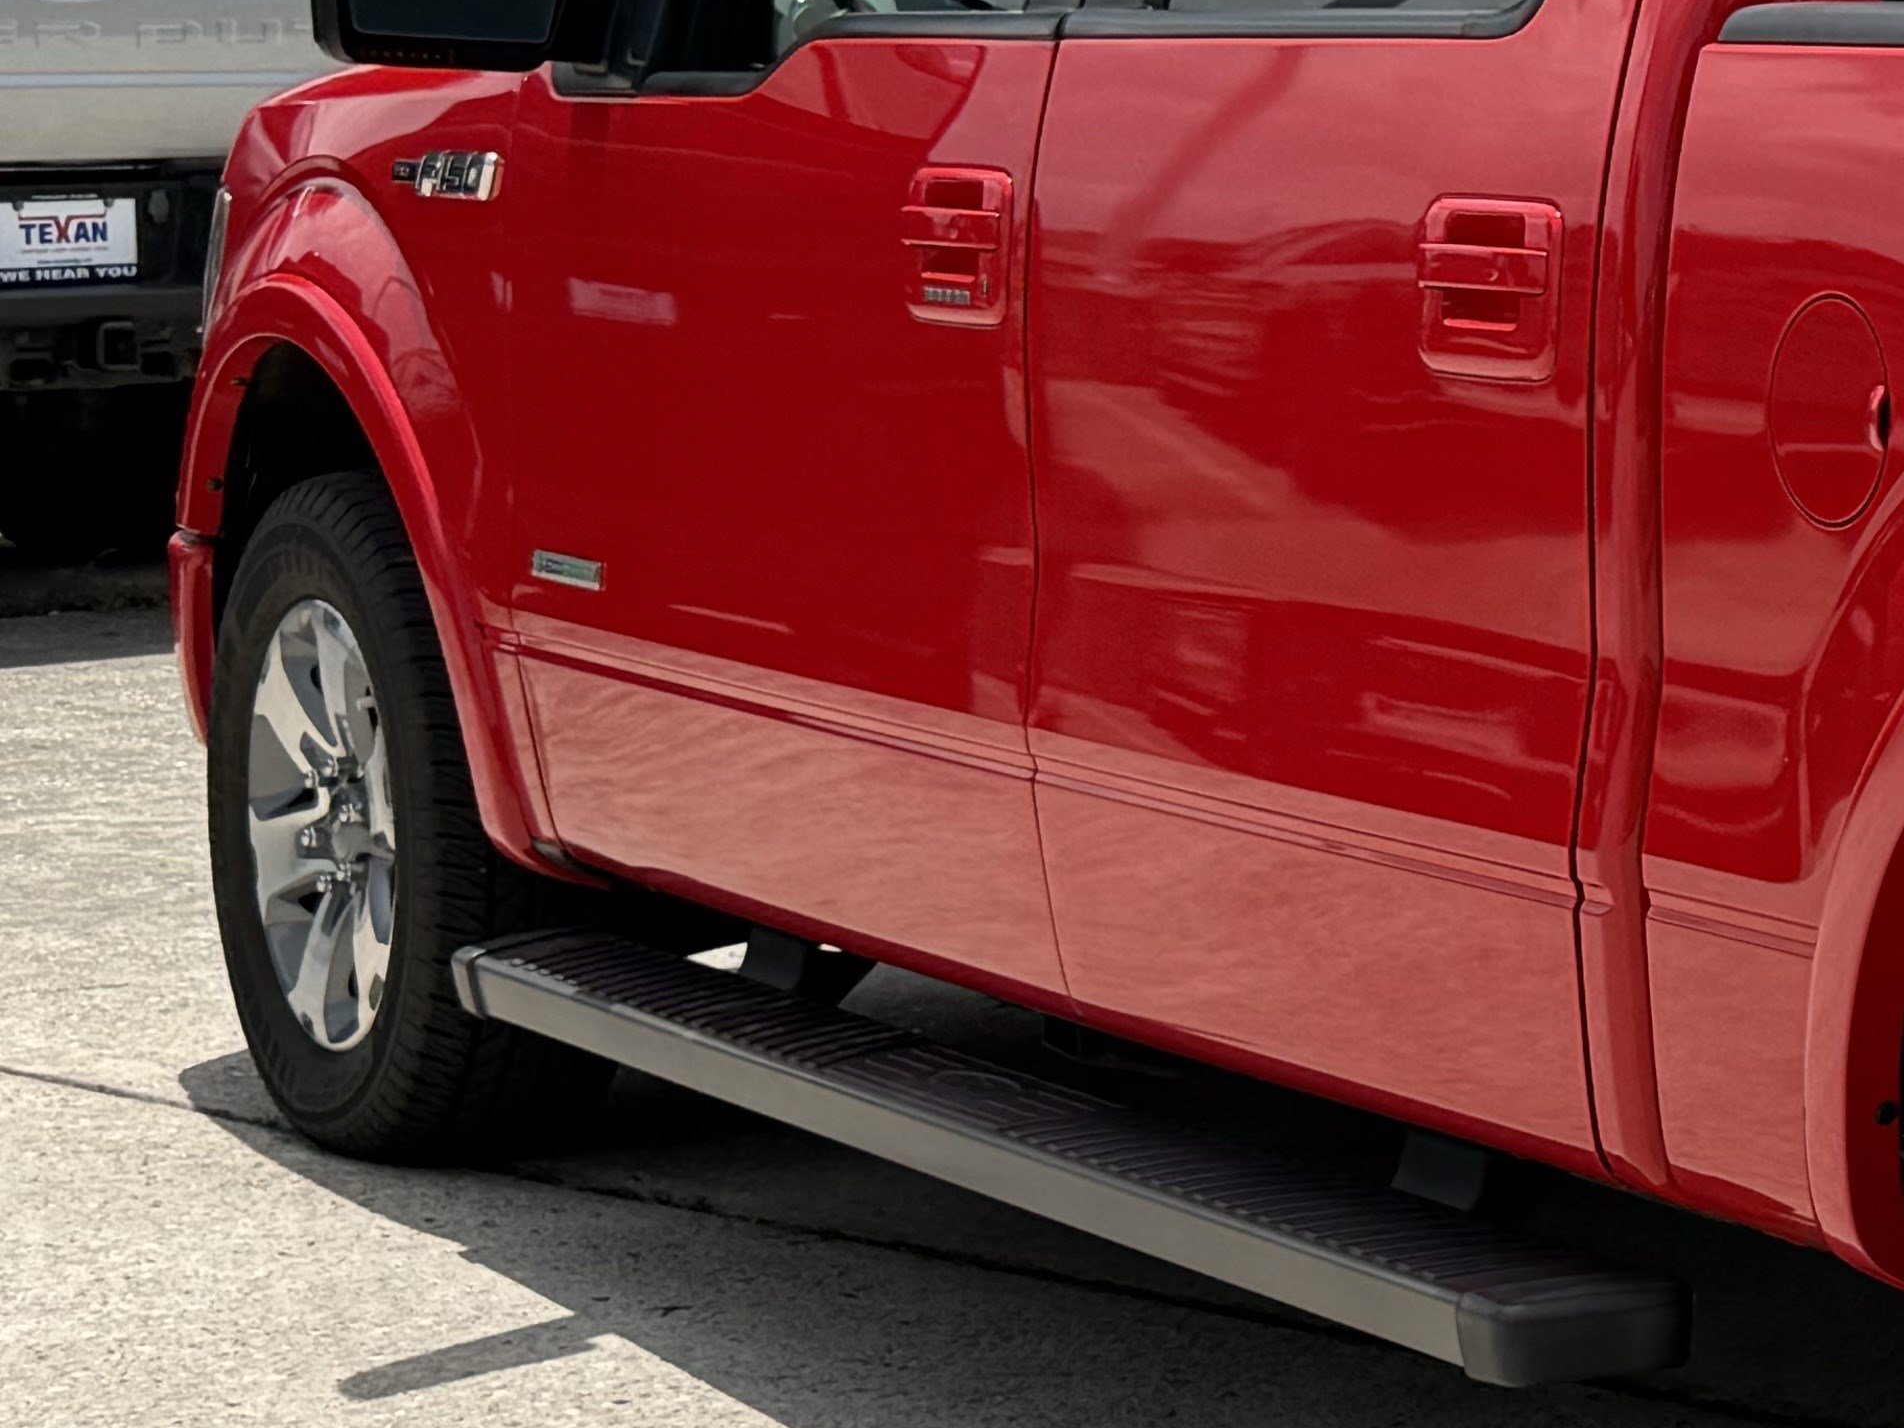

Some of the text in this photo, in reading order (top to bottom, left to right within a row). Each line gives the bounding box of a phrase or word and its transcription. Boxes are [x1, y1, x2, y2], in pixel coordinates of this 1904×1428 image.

[18, 215, 108, 245] TEXAN
[35, 267, 90, 281] HEAR
[95, 265, 138, 279] YOU
